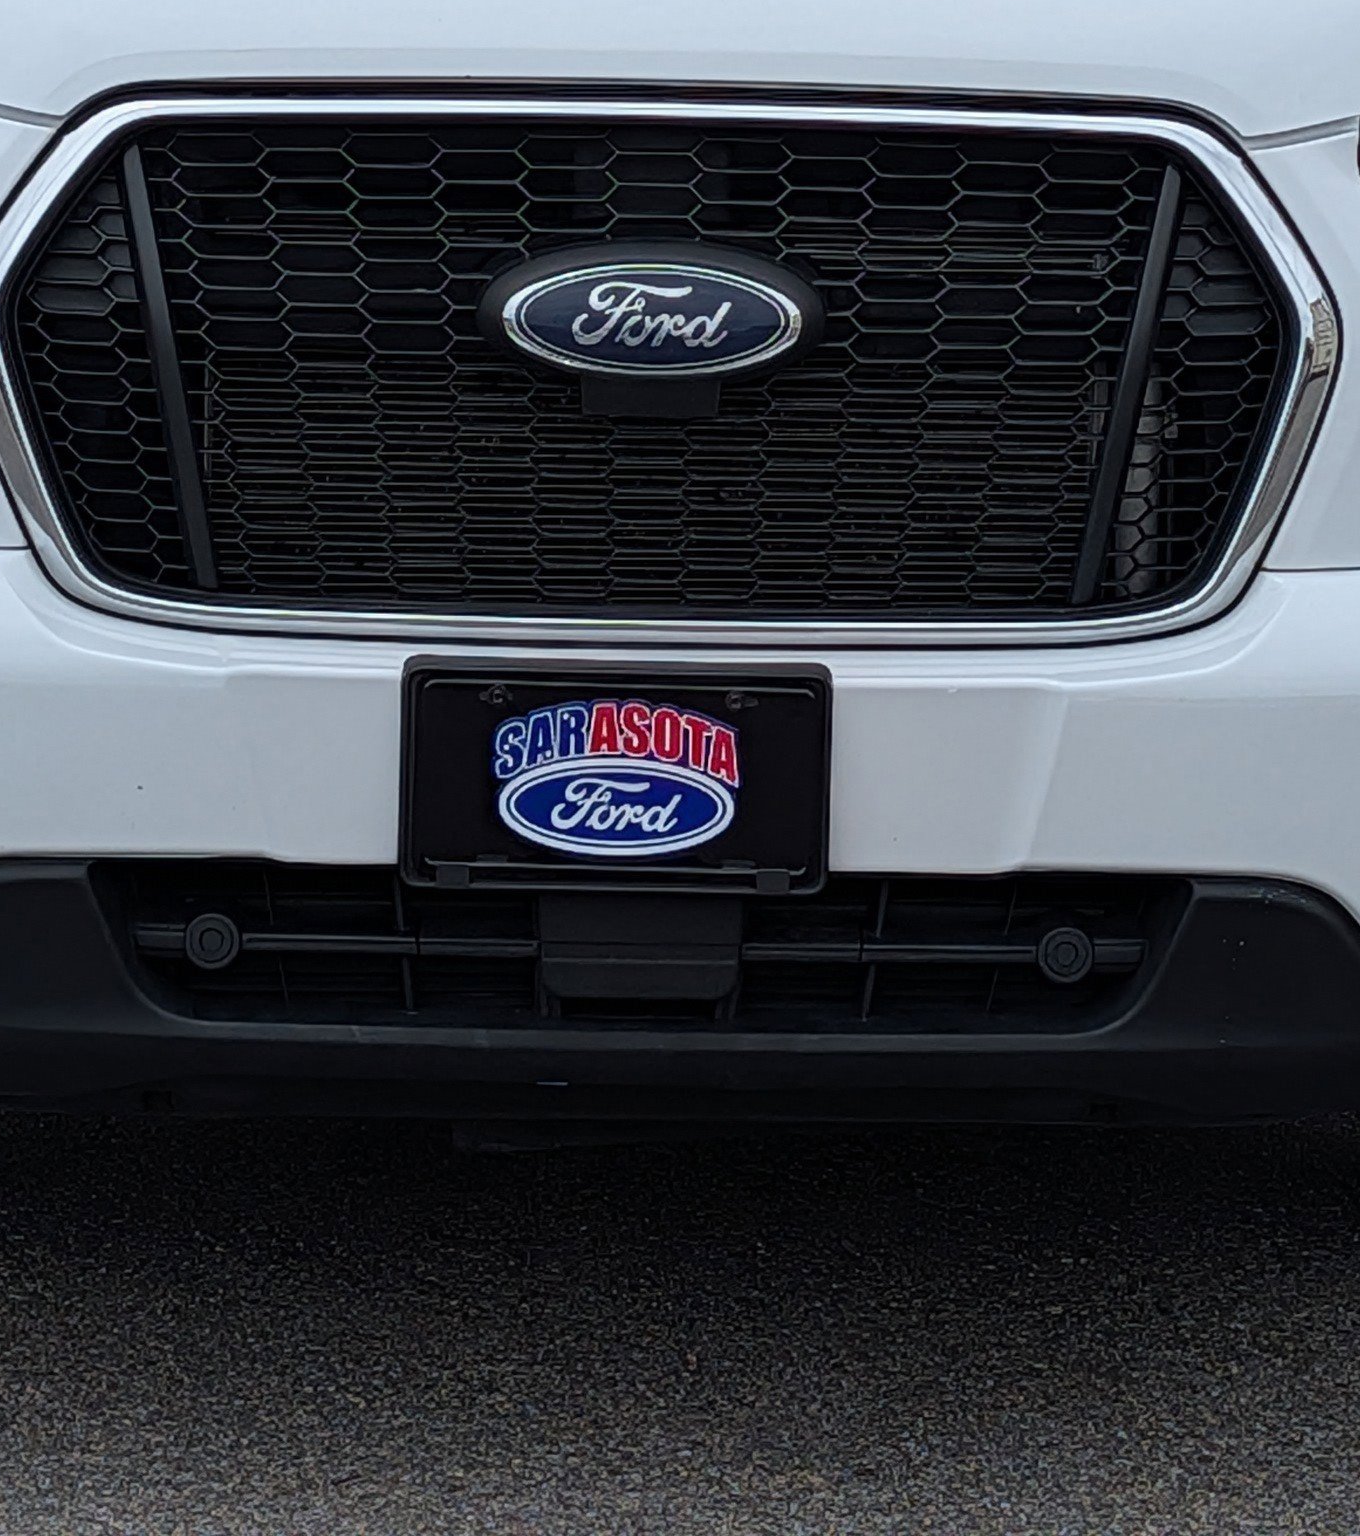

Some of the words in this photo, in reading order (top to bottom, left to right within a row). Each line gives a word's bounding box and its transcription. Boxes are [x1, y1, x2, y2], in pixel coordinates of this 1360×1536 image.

[572, 280, 733, 348] Ford
[494, 701, 740, 788] SARASOTA
[551, 777, 683, 833] Ford
